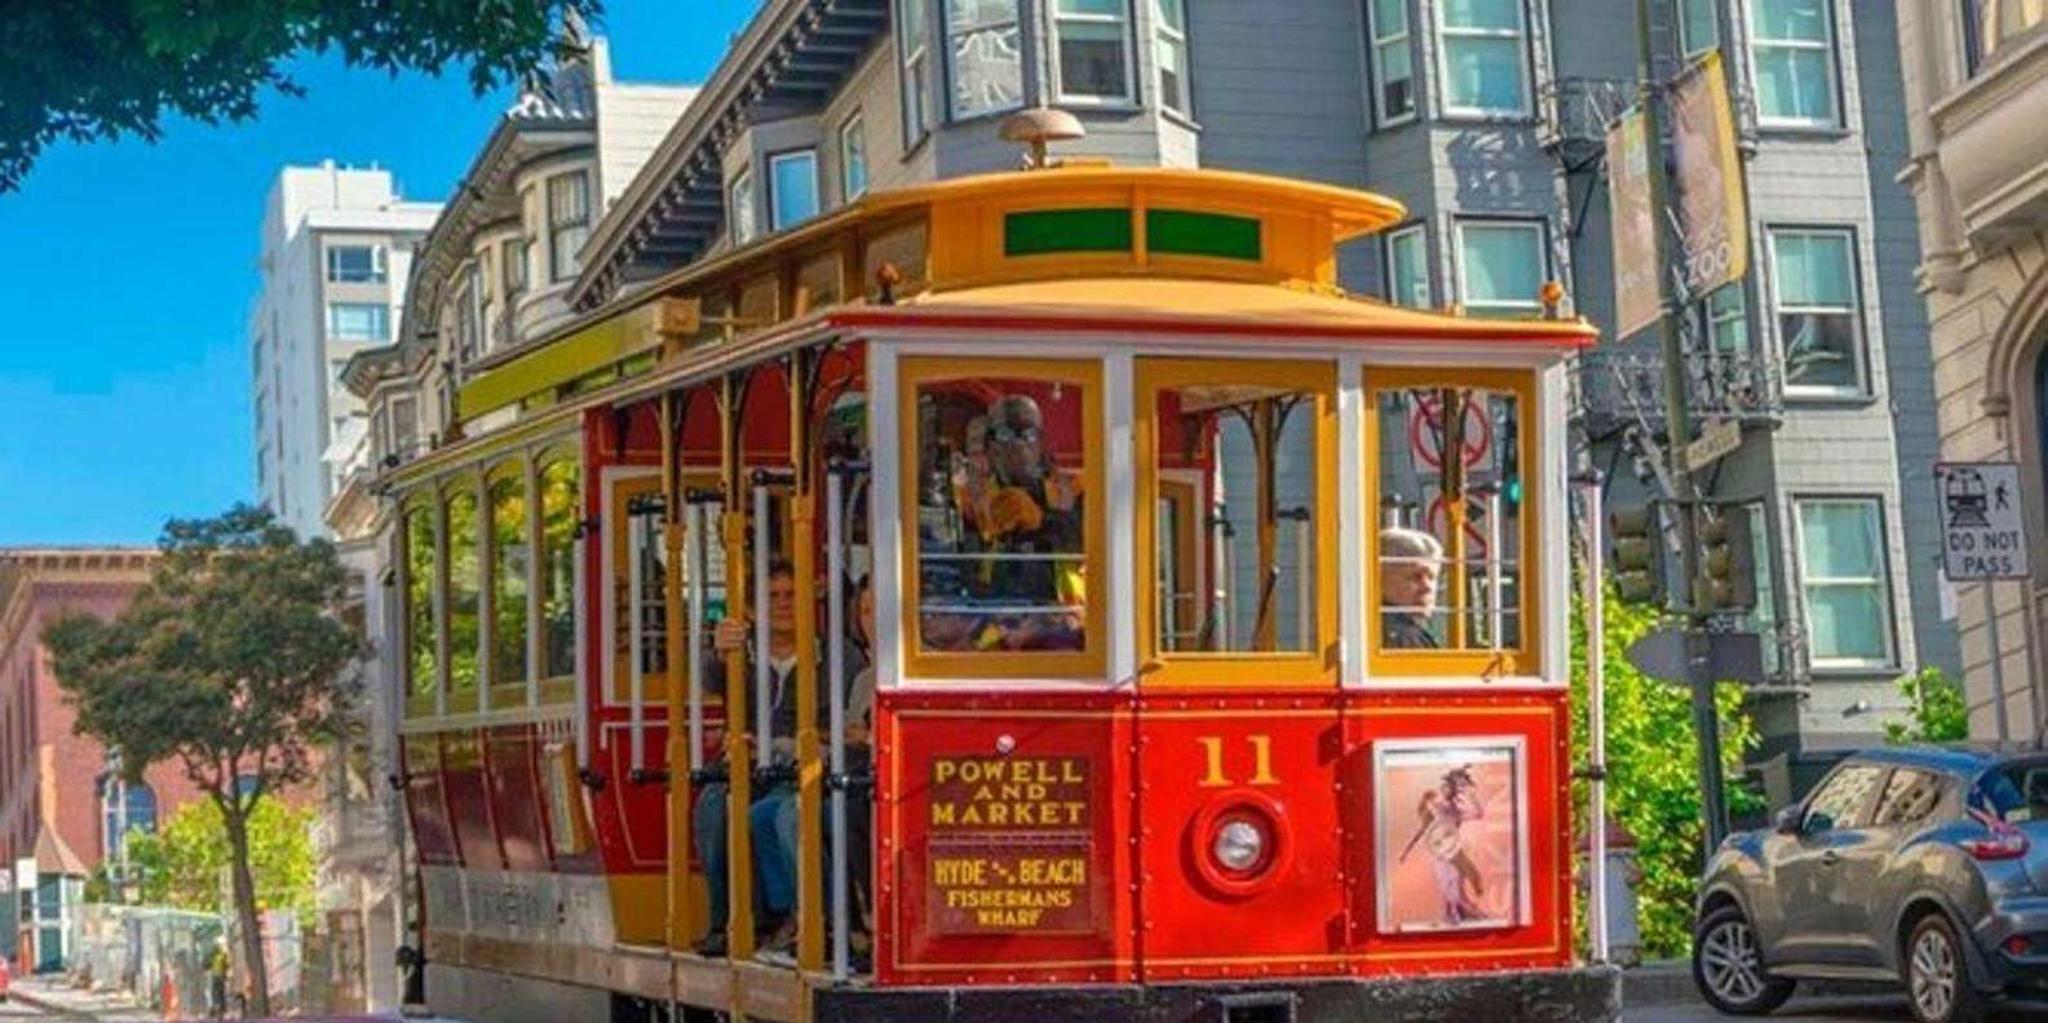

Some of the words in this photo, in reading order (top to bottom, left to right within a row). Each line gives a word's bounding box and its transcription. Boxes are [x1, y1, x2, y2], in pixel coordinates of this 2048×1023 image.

[1684, 241, 1731, 288] ZOO
[1949, 531, 1976, 552] DO
[1983, 530, 2018, 551] NOT
[1963, 556, 2013, 574] PASS
[935, 760, 1084, 783] POWELL
[1195, 734, 1282, 787] 11
[973, 784, 1047, 800] AND
[931, 802, 1086, 825] MARKET
[933, 859, 988, 885] HYDE
[1019, 859, 1086, 885] BEACH
[947, 889, 1072, 908] FISHERMANS
[976, 909, 1044, 926] WHARF
